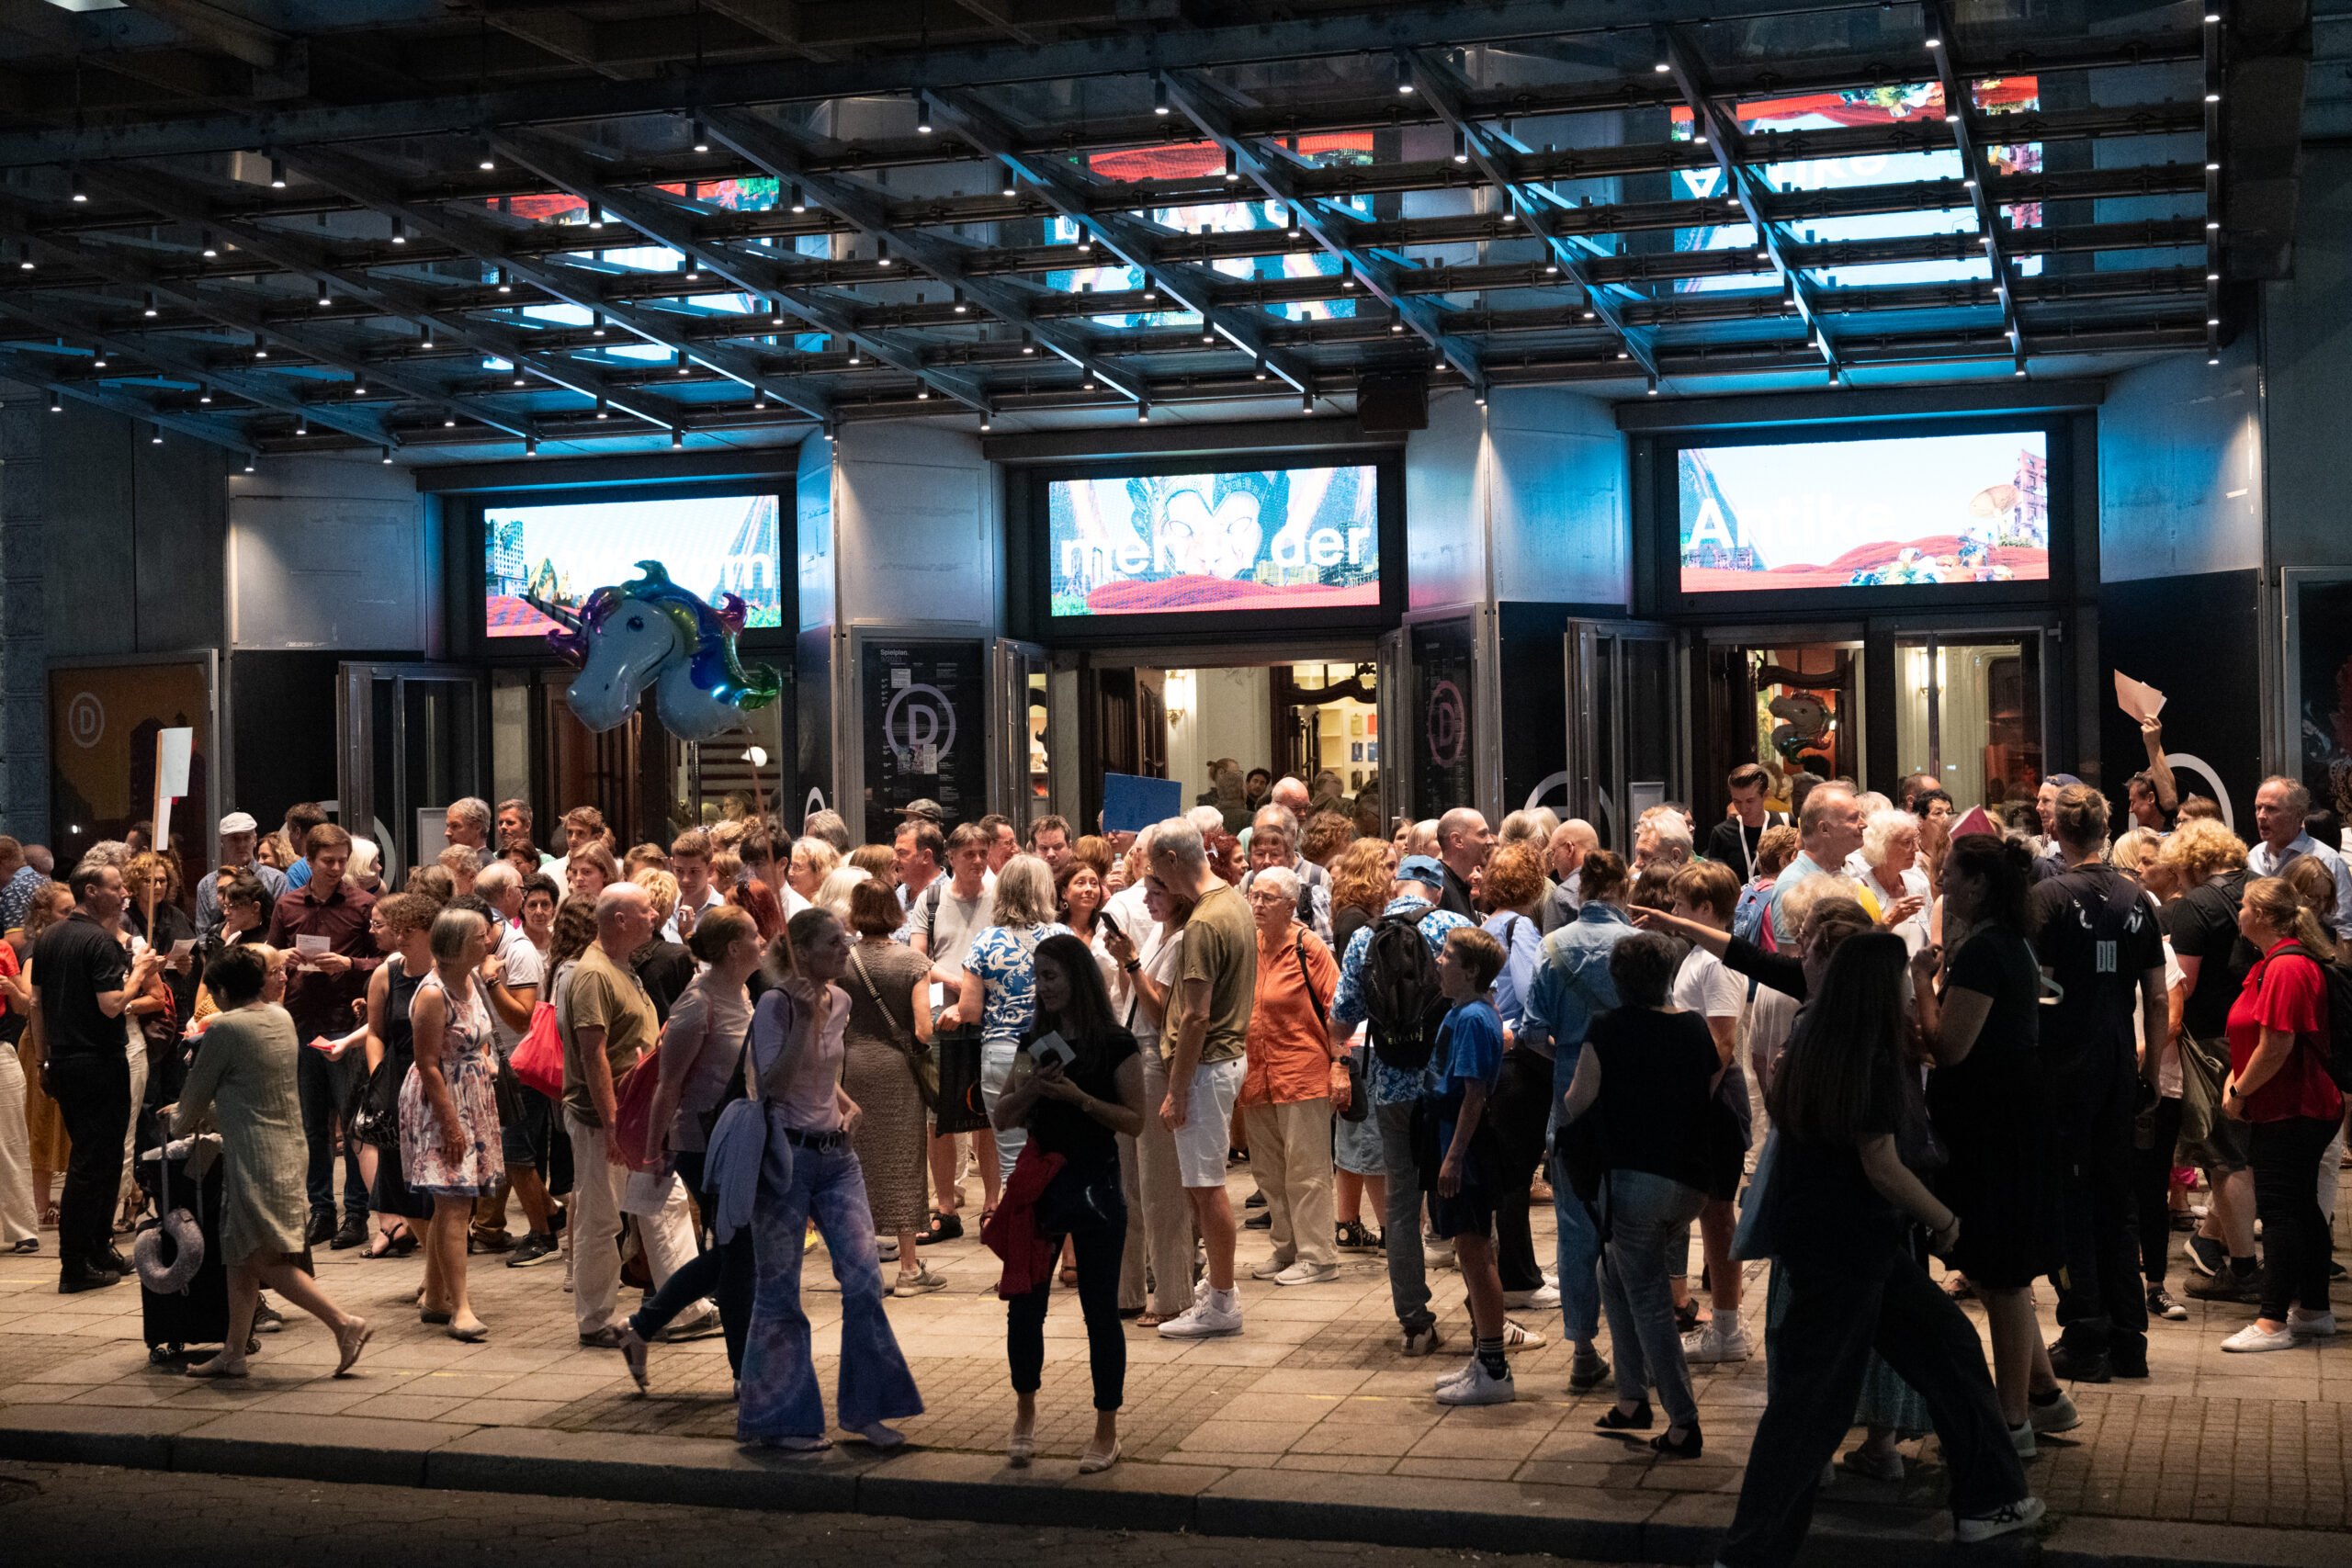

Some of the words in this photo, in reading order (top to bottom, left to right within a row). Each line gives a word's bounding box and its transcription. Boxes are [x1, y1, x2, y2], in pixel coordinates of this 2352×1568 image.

[1271, 517, 1371, 568] der
[1688, 493, 1897, 549] Antike
[80, 706, 95, 734] D
[909, 705, 938, 745] D
[1440, 703, 1455, 746] D
